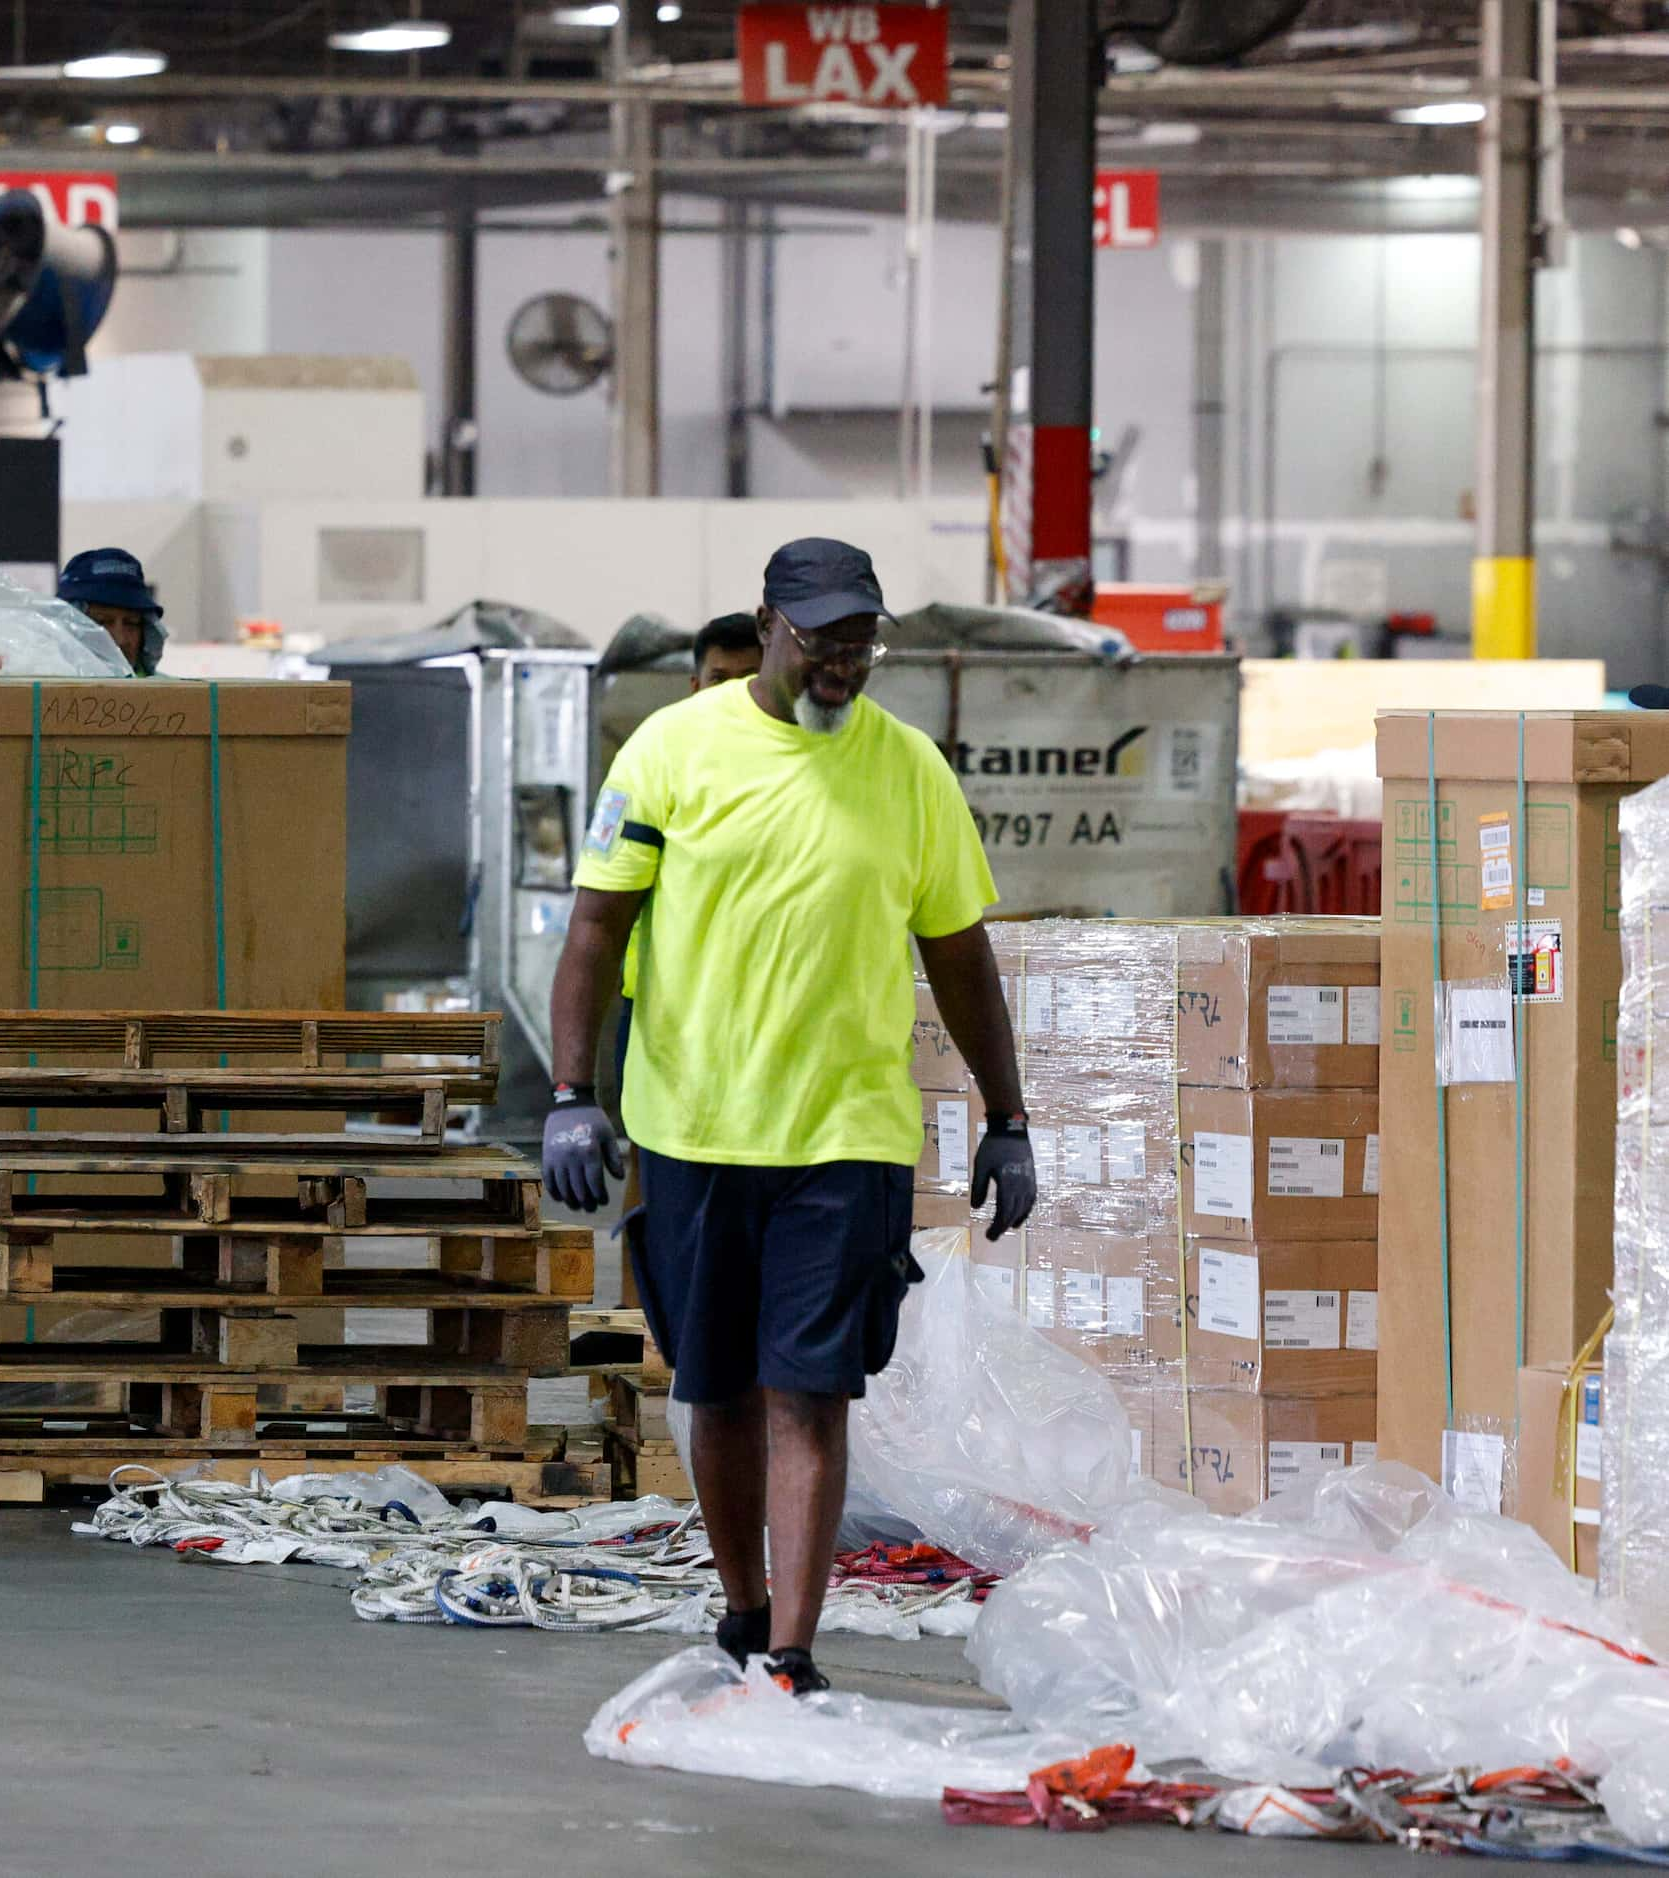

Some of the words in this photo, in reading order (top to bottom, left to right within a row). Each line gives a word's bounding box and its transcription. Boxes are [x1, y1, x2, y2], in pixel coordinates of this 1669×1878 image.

[807, 7, 880, 43] WB
[764, 42, 919, 101] LAX
[1070, 812, 1122, 846] AA
